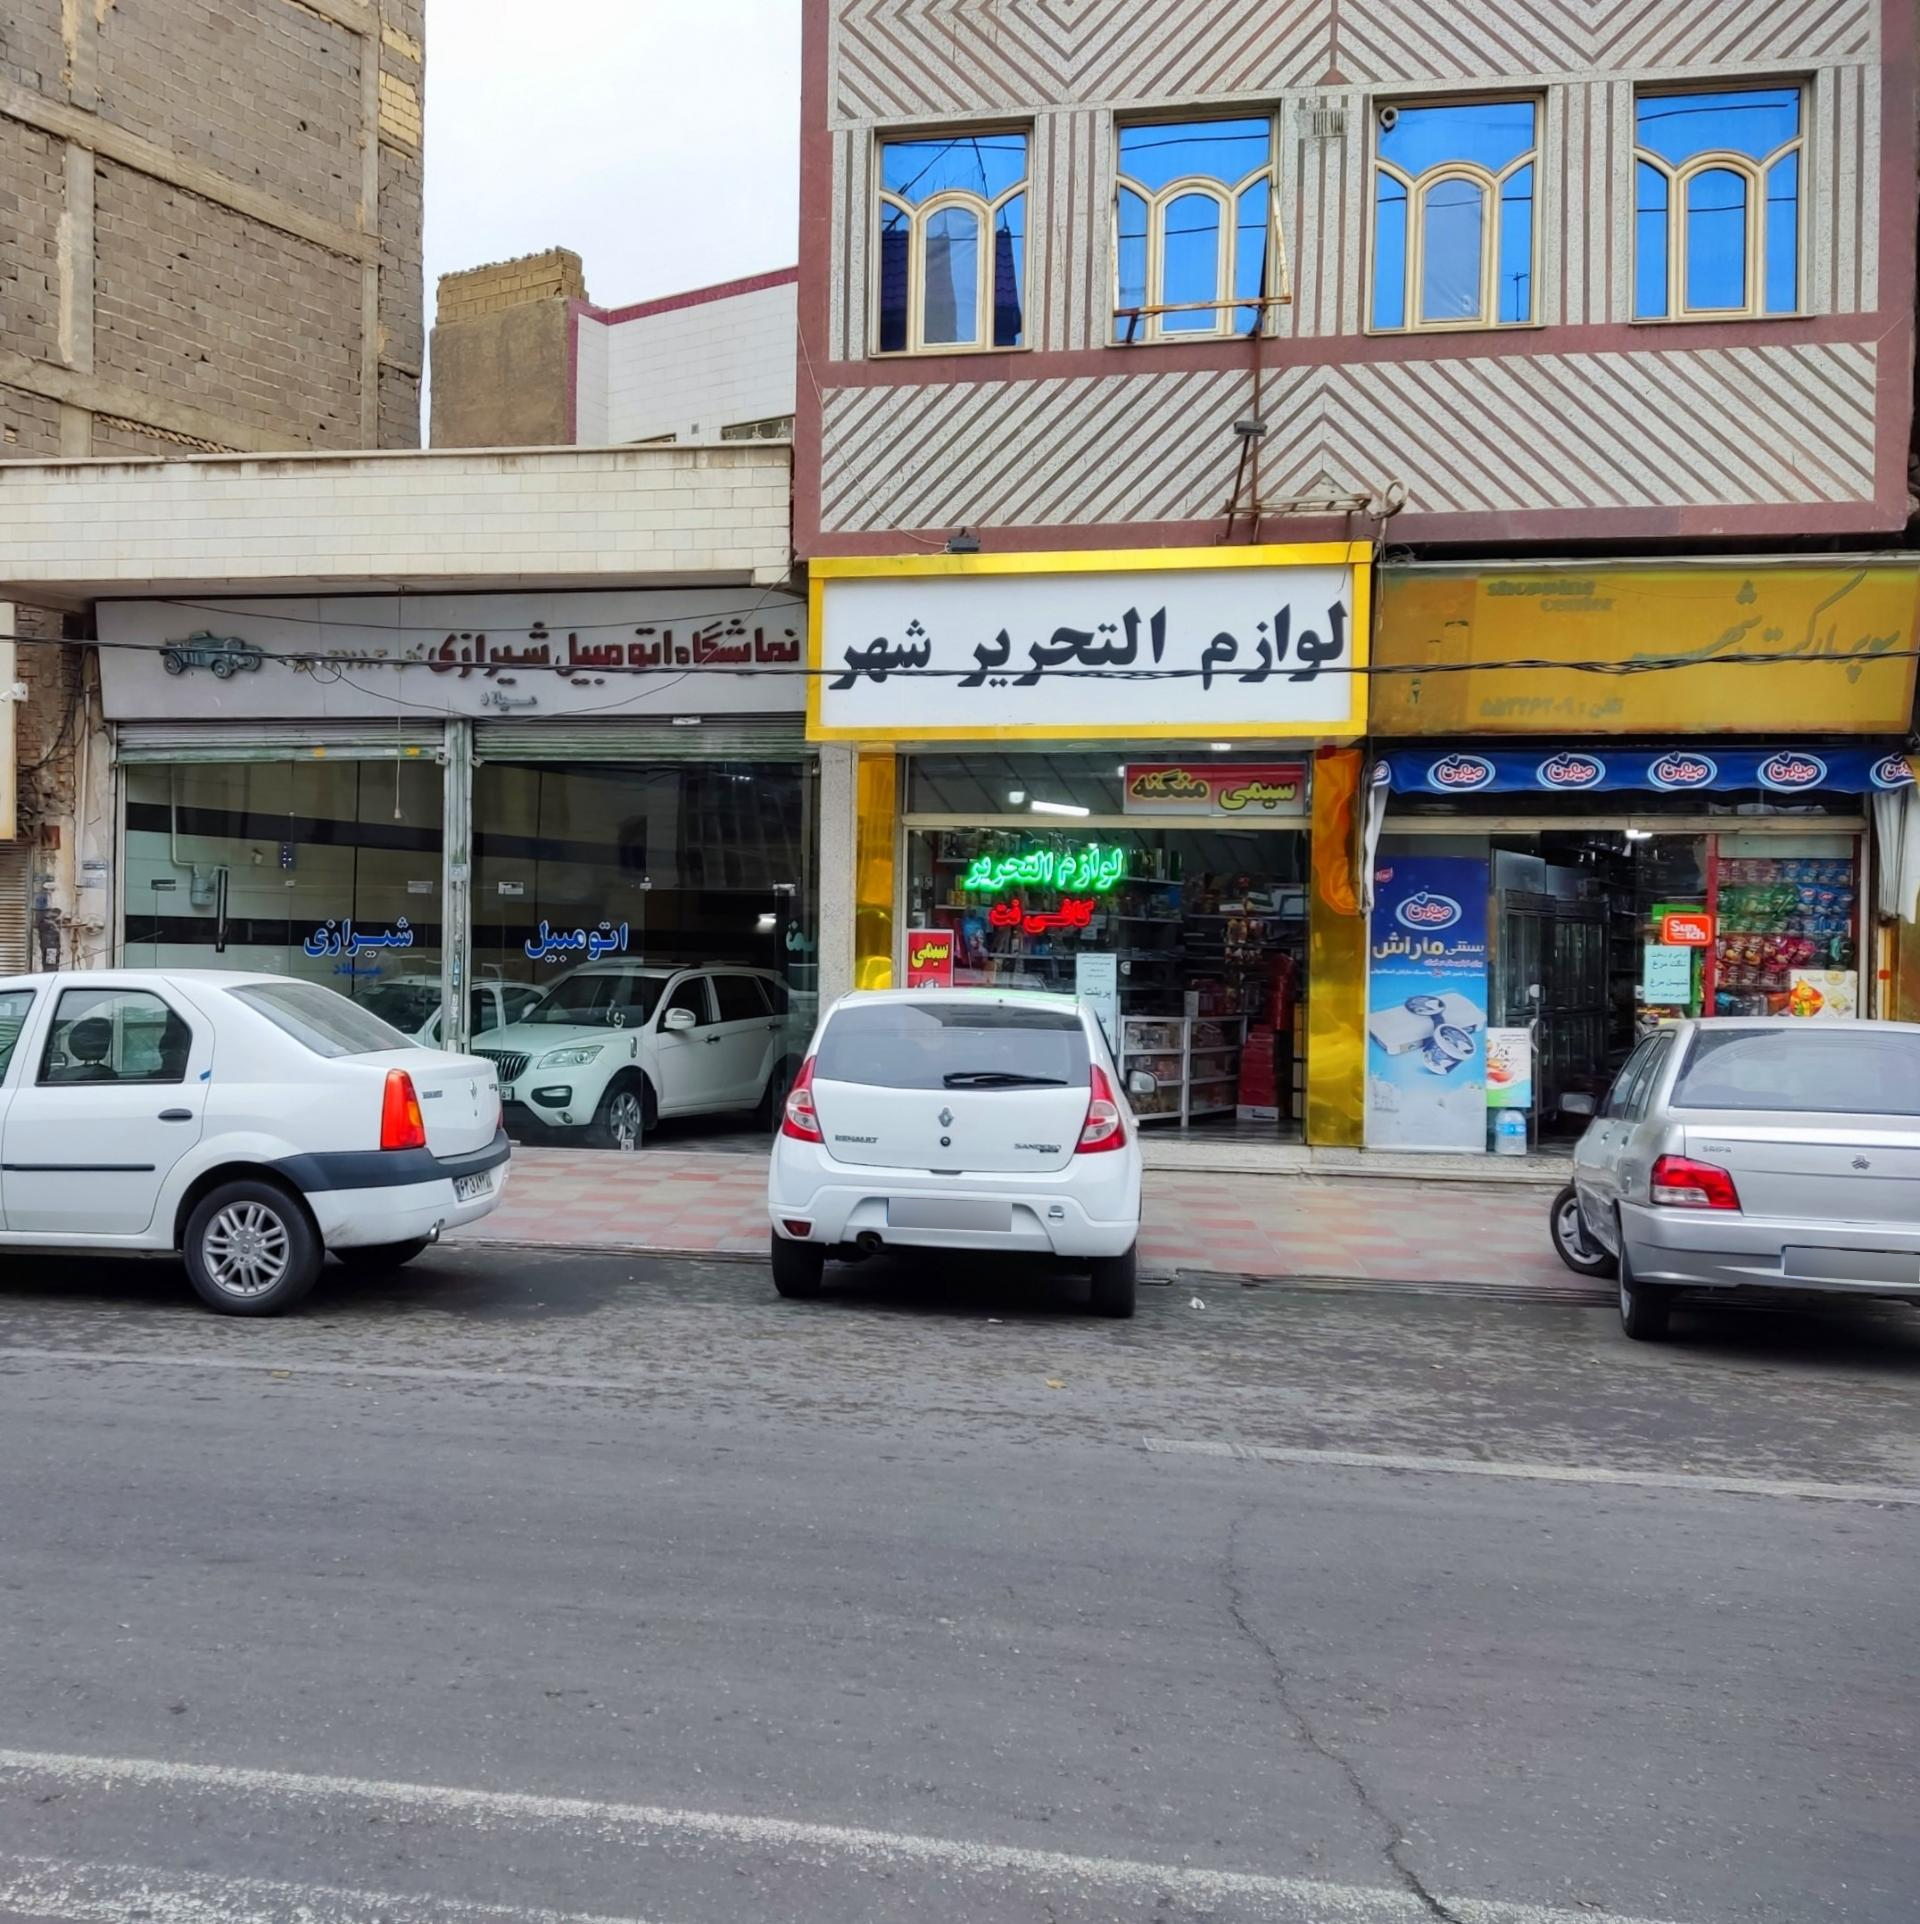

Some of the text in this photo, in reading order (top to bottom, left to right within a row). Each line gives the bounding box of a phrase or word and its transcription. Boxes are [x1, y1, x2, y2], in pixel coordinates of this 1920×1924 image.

[1630, 578, 1763, 673] شهر
[428, 620, 550, 686] شیرازی
[827, 600, 1348, 691] لوازم التحریر شهر
[1438, 763, 1485, 783] میهن
[1548, 763, 1596, 783] میهن
[1658, 762, 1707, 782] میهن
[1768, 762, 1817, 782] میهن
[1130, 769, 1297, 810] سیمی منگنه
[964, 847, 1124, 889] لوازم التحریر
[989, 898, 1095, 933] کافی نت
[1406, 903, 1453, 922] میهن
[303, 915, 414, 958] شیرازی
[524, 919, 629, 962] اتومبیل
[1372, 931, 1444, 960] ماراش
[911, 942, 949, 968] سیمی
[834, 1134, 879, 1145] RENAULT
[1013, 1142, 1062, 1151] SANDERO
[1702, 1145, 1732, 1153] SAIPA
